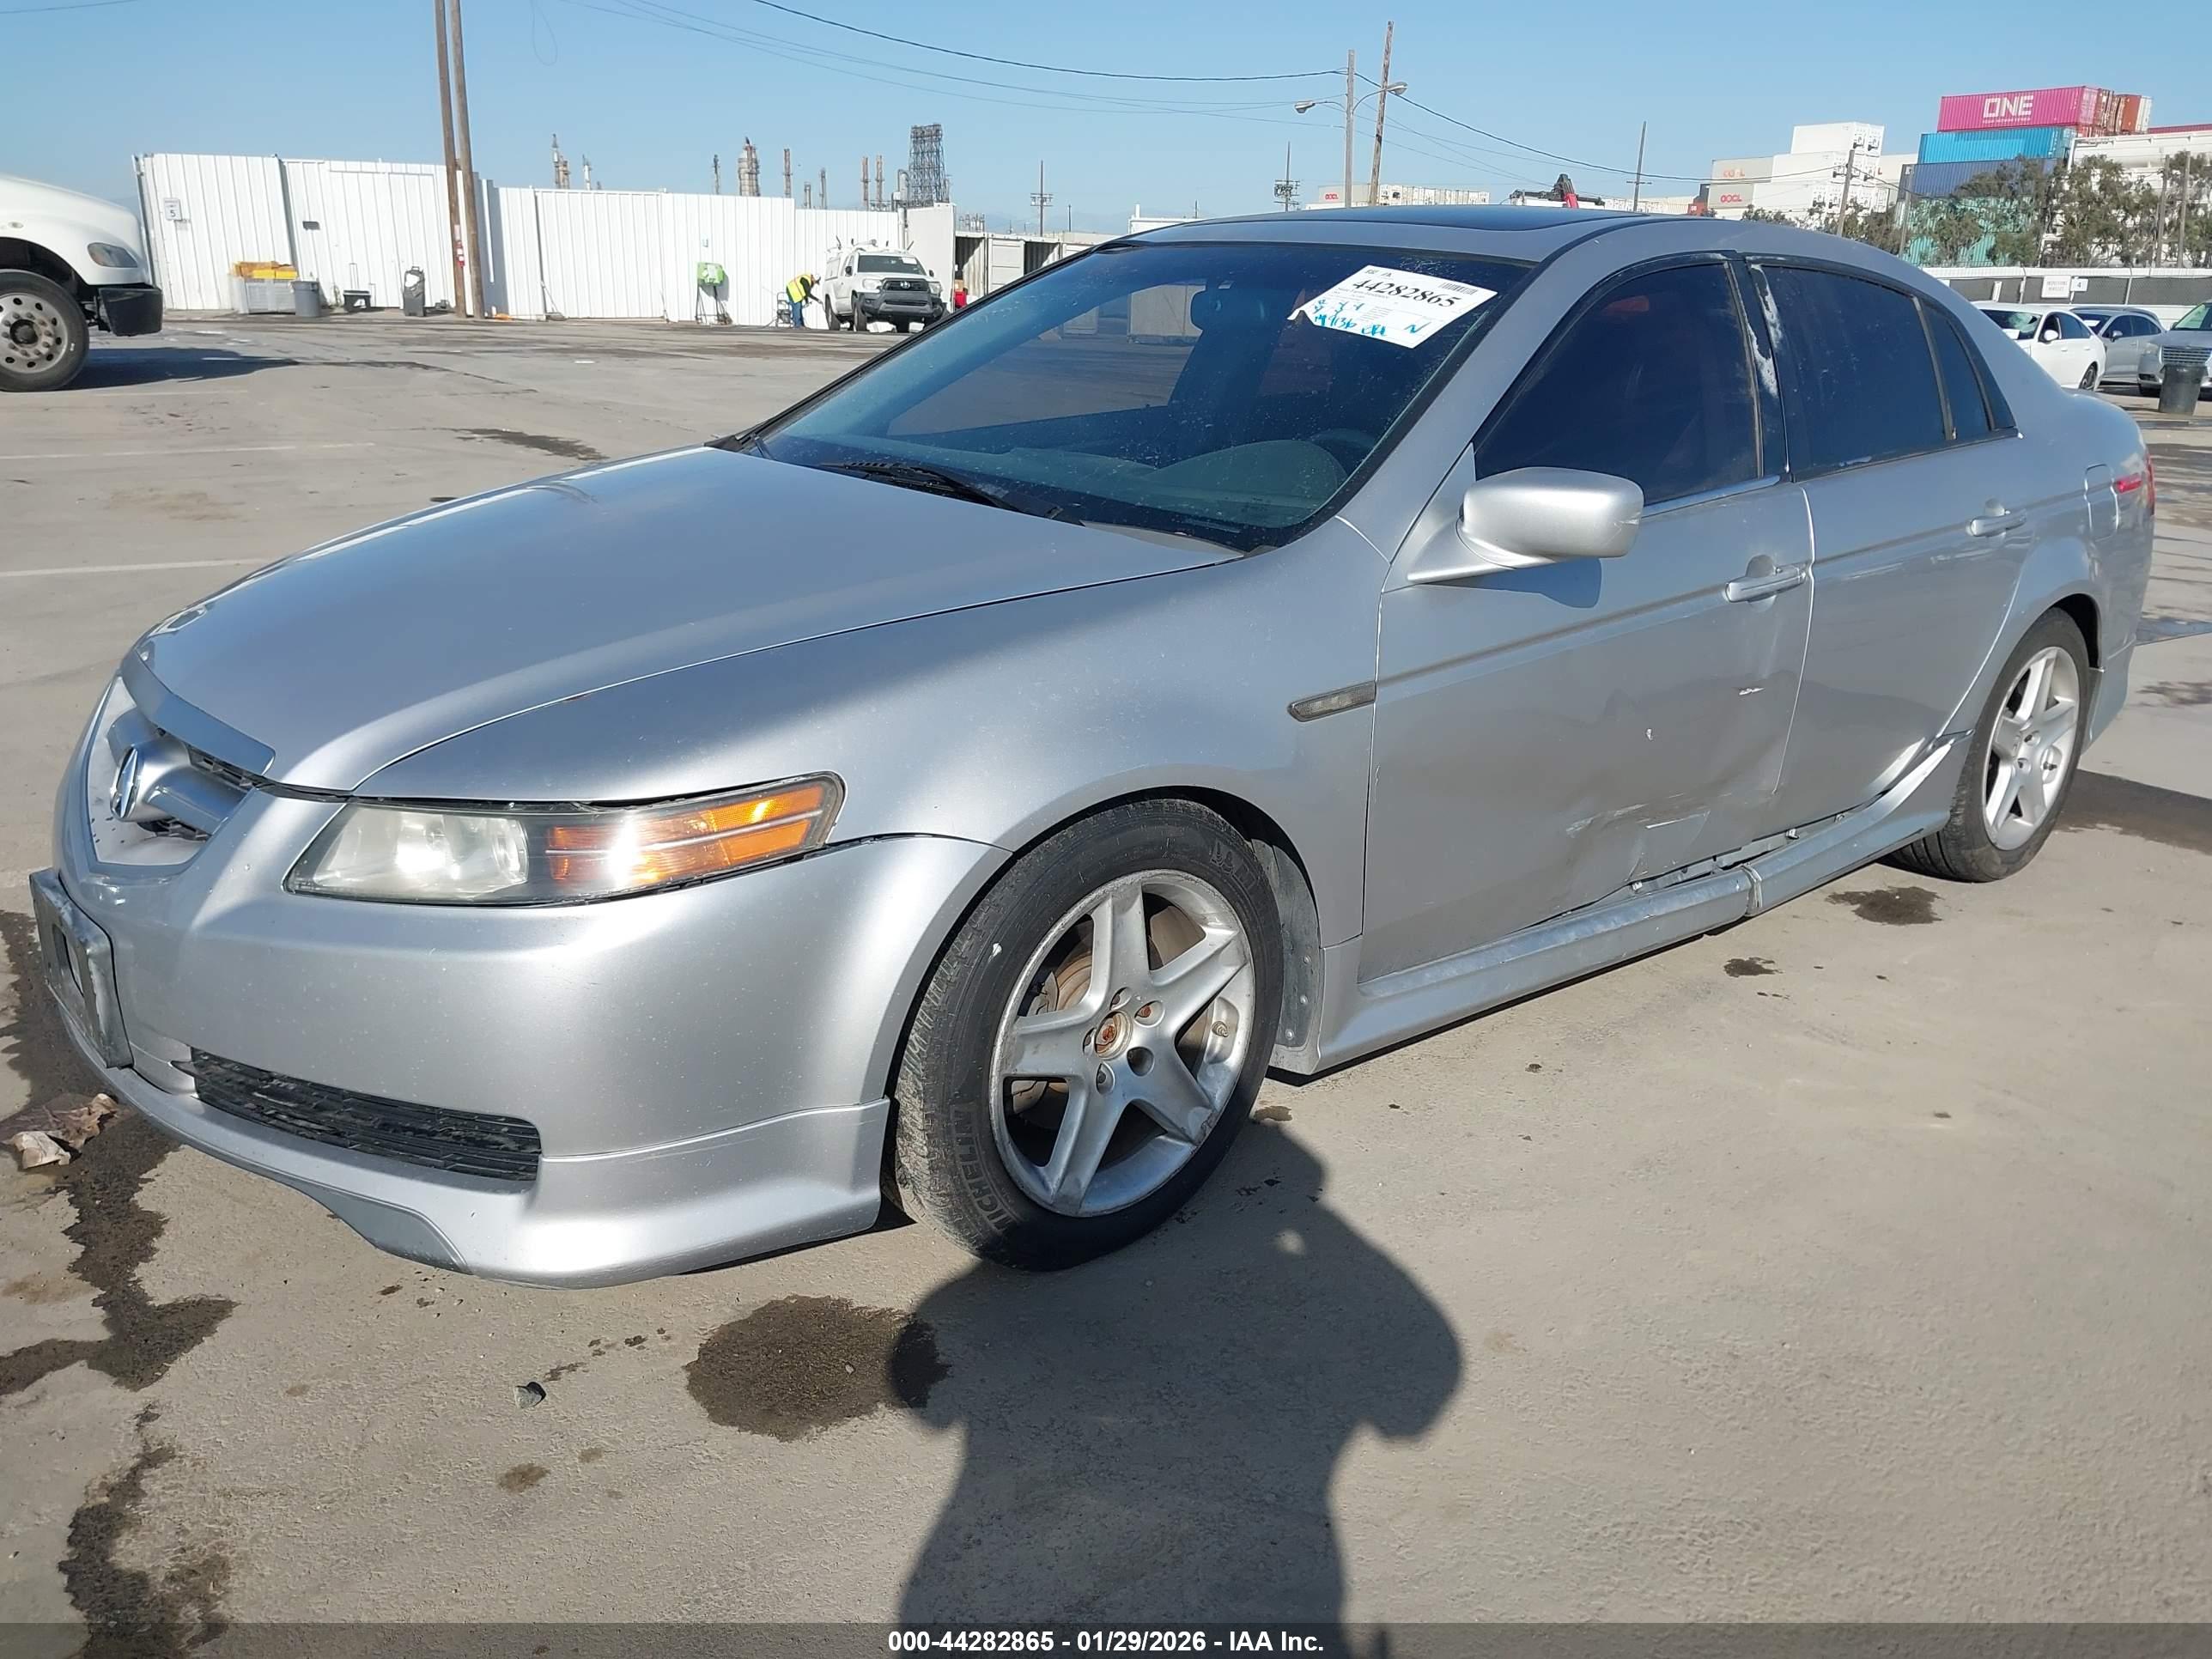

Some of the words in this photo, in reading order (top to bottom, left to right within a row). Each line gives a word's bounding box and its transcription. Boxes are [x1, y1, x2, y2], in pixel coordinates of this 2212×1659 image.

[1983, 94, 2033, 118] ONE
[1720, 194, 1742, 203] OOCL
[1352, 279, 1462, 307] 44282865
